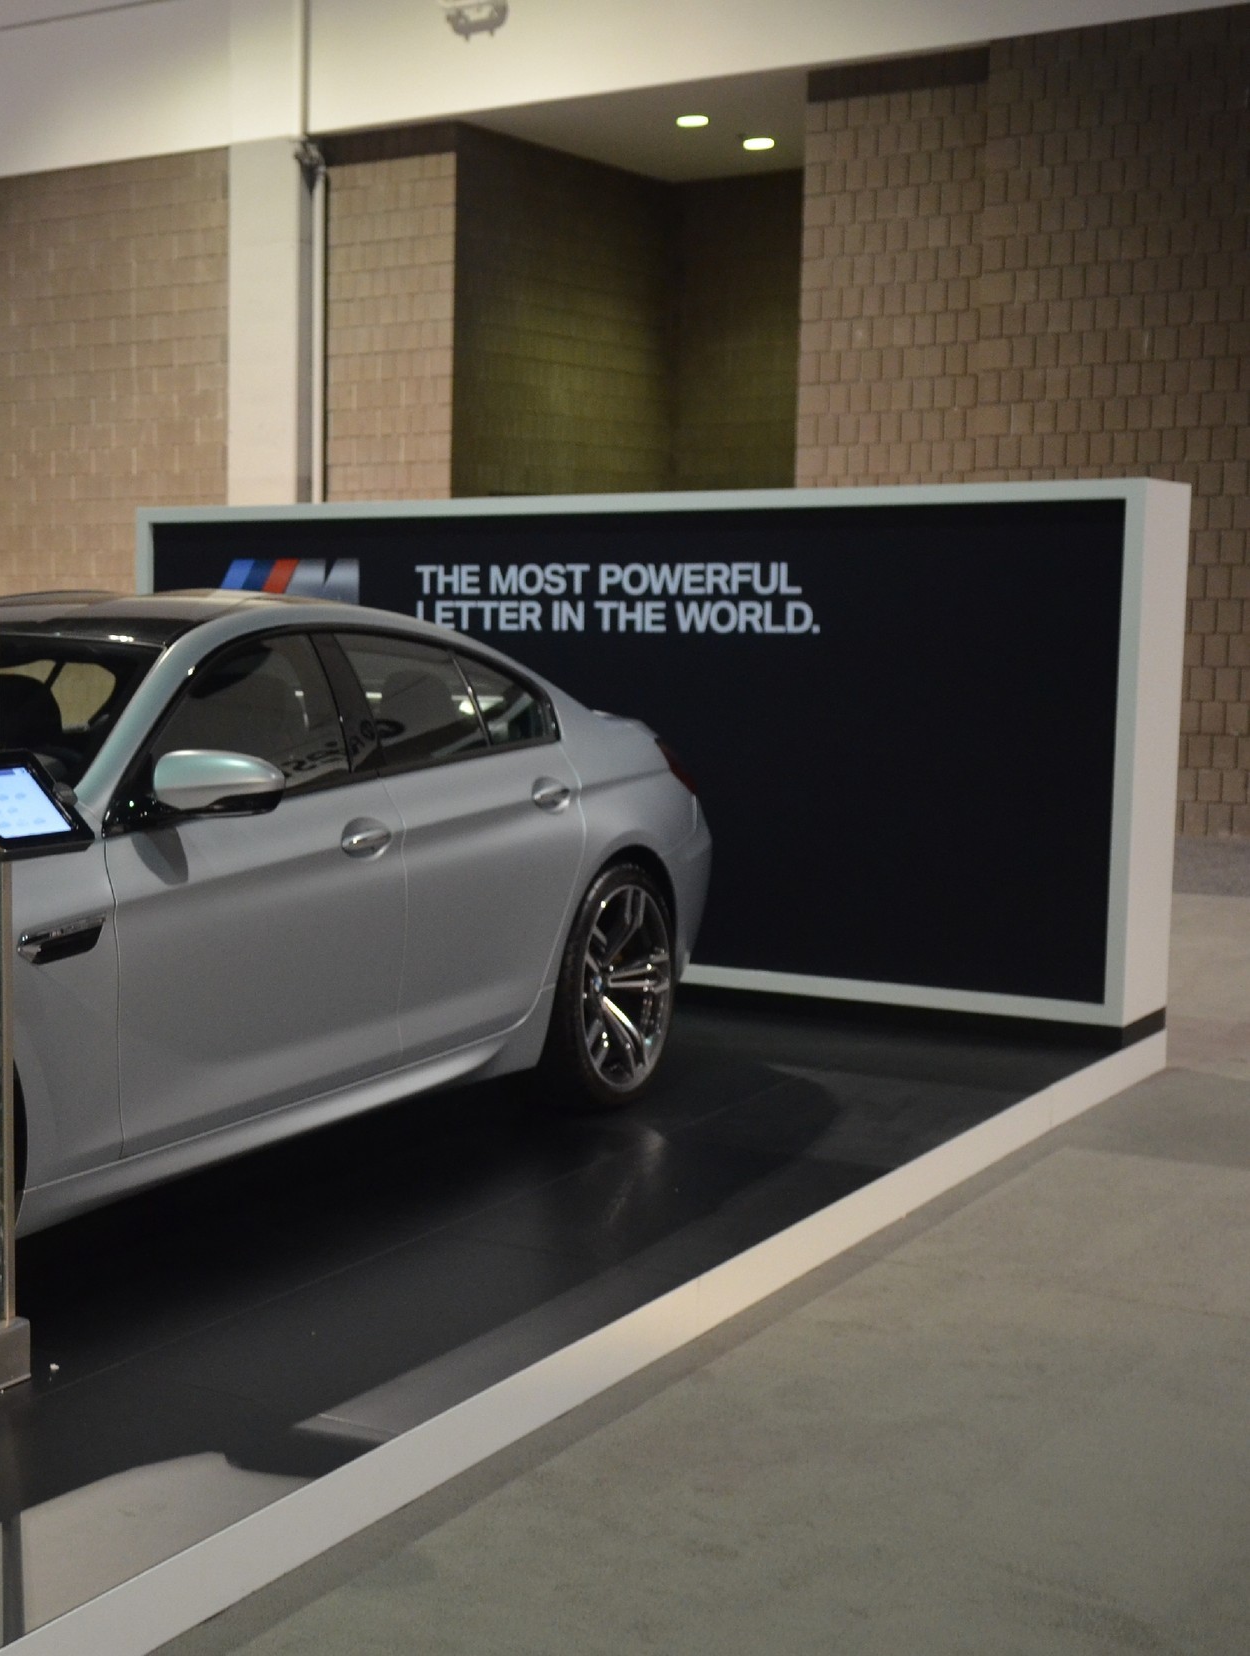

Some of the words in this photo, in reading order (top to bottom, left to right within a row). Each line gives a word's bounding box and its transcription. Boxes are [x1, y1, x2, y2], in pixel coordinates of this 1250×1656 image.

[415, 564, 481, 596] THE
[489, 563, 590, 596] MOST
[598, 562, 802, 596] POWERFUL
[552, 600, 585, 632] IN
[594, 600, 667, 633] THE
[675, 600, 821, 634] WORLD.
